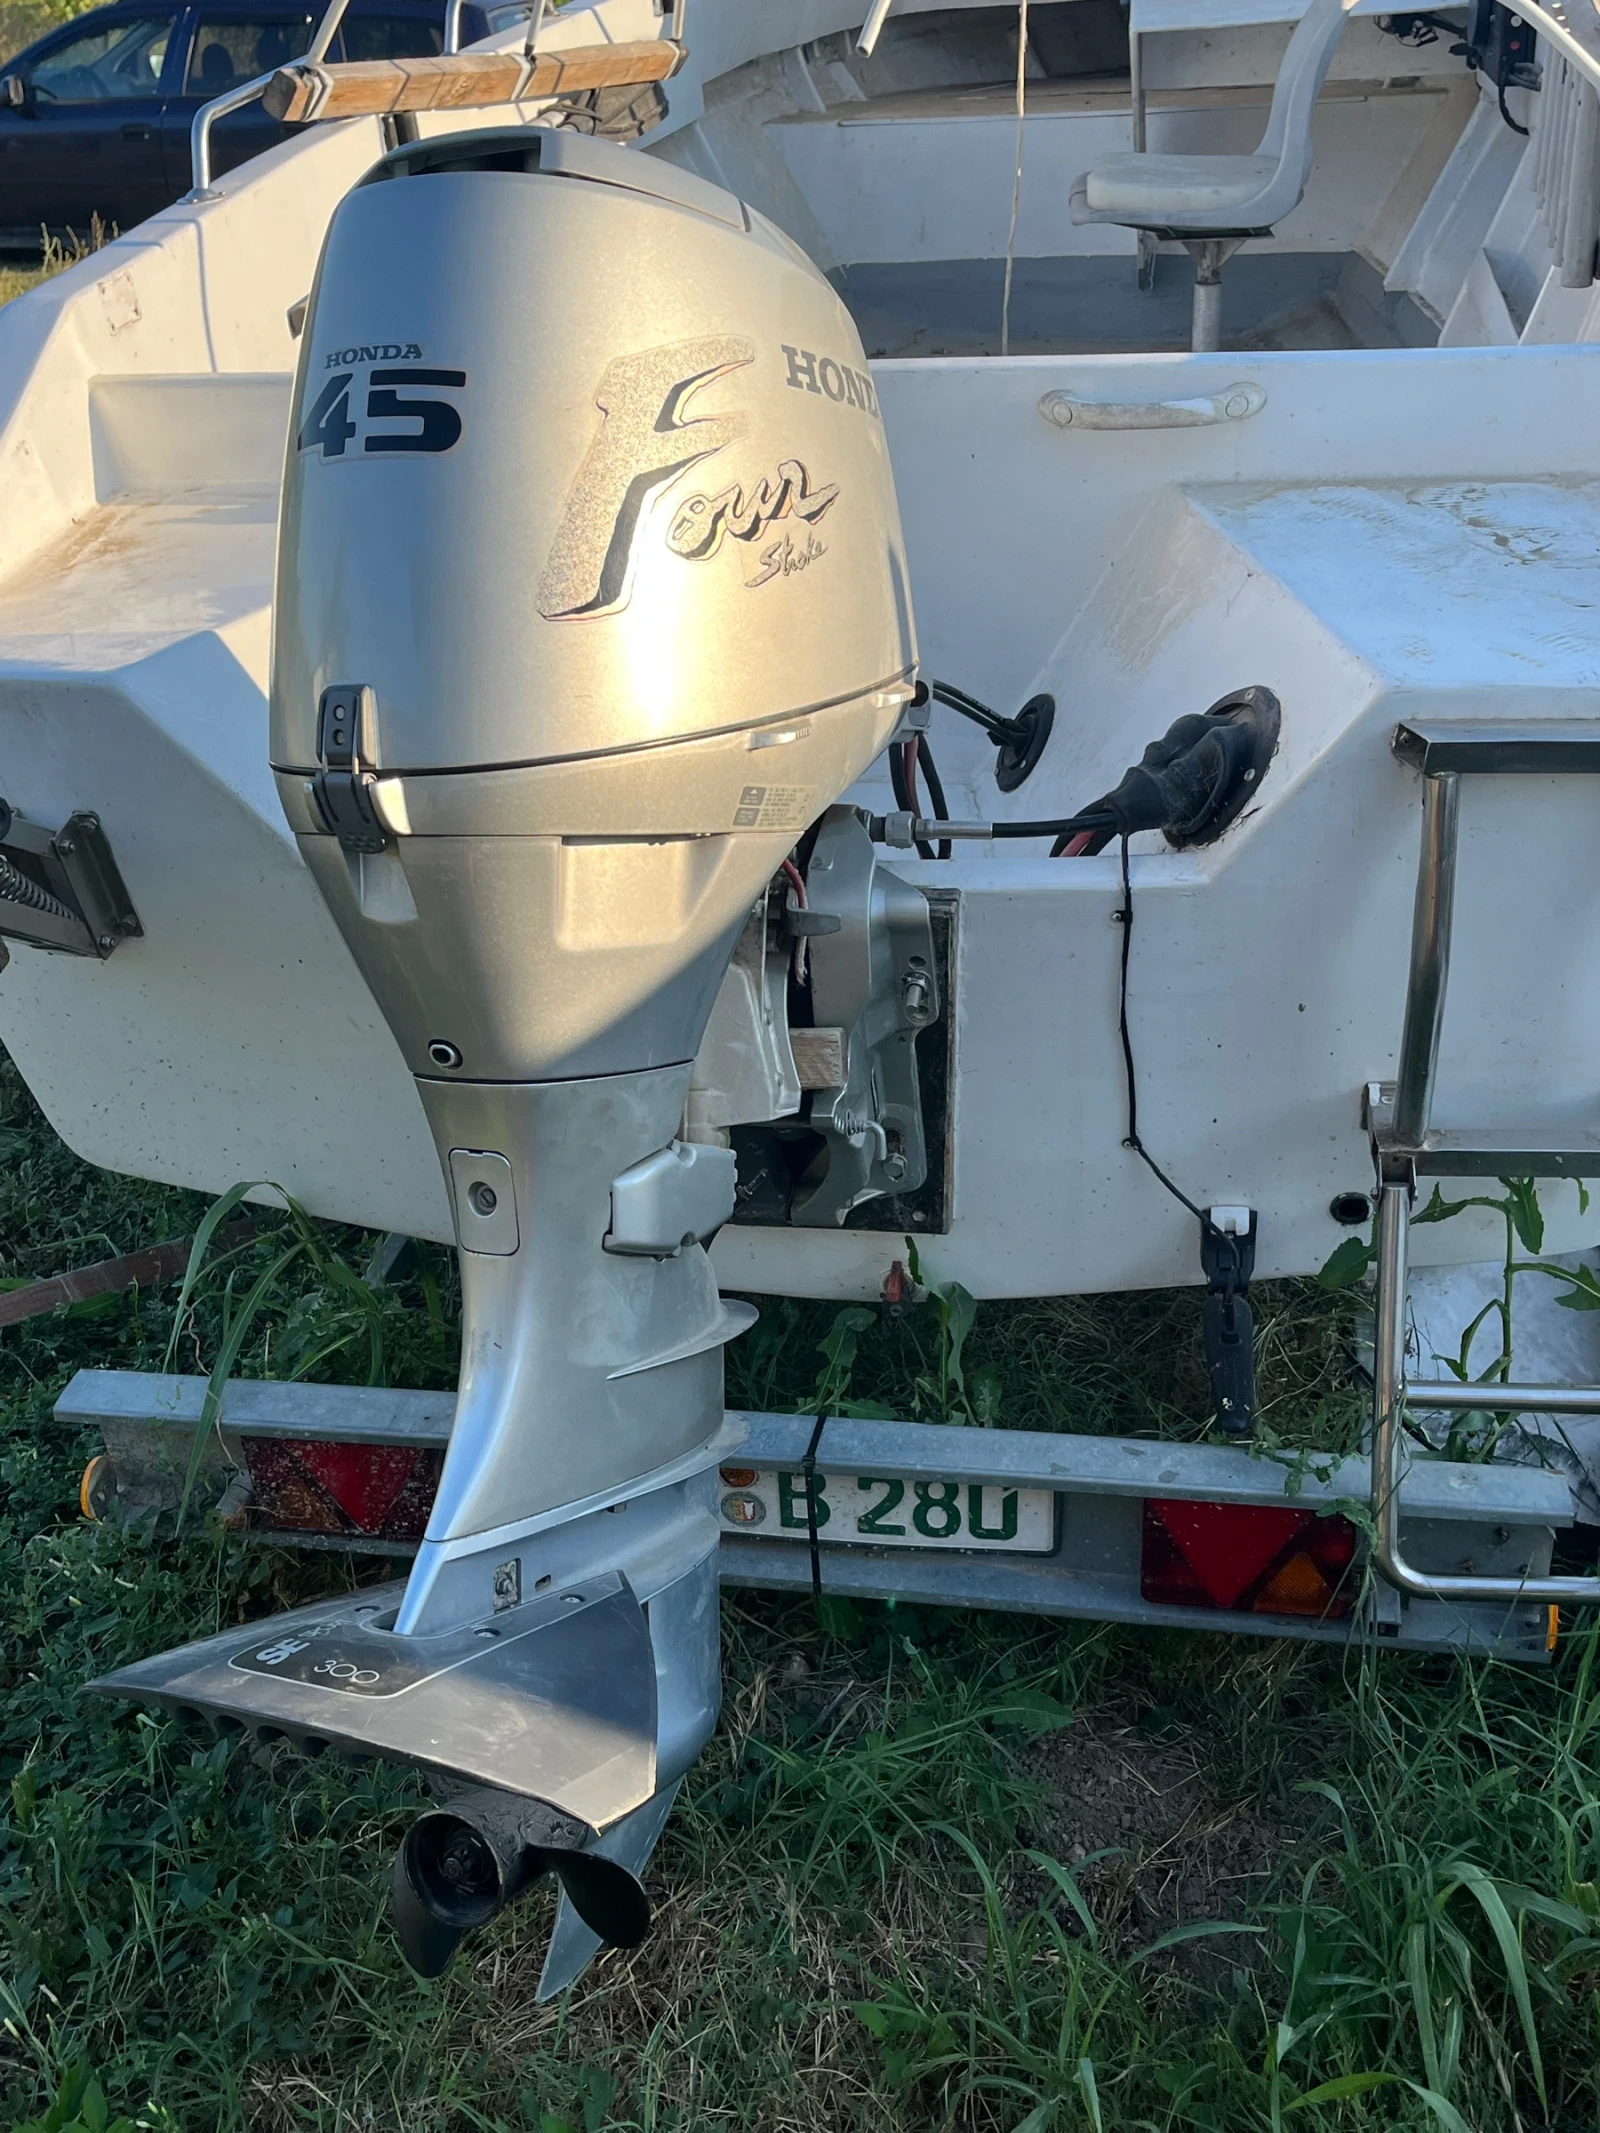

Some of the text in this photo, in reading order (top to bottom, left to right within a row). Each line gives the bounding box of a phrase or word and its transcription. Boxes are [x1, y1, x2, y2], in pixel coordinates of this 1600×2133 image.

[324, 343, 423, 370] HONDA
[780, 343, 882, 421] HOND
[297, 368, 467, 458] 45
[534, 334, 841, 622] Four
[744, 531, 829, 589] Stroke
[857, 1475, 1019, 1541] 280
[255, 1637, 310, 1666] SE
[313, 1659, 381, 1684] 300
